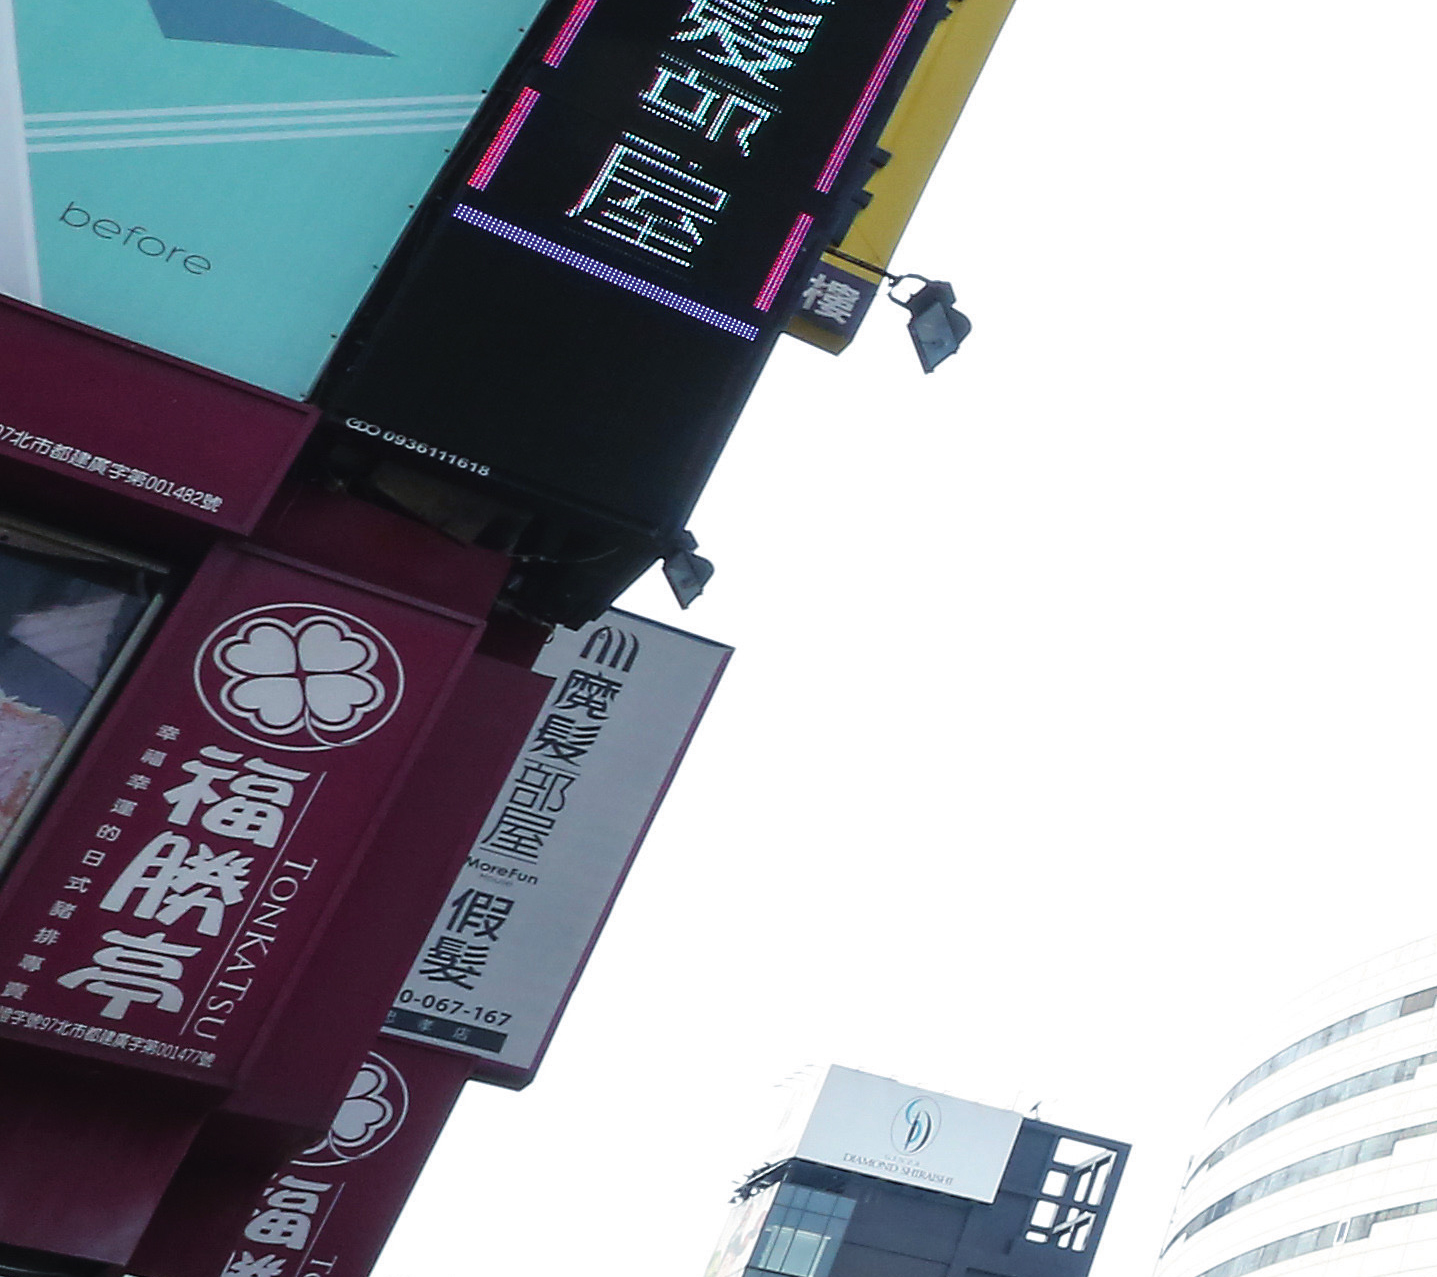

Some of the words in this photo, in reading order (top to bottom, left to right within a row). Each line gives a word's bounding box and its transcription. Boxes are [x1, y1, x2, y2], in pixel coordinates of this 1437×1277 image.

[56, 199, 215, 280] before
[383, 429, 491, 478] 0936111618
[57, 745, 311, 1021] 福勝亭
[192, 856, 319, 1042] TONKATSU
[418, 887, 515, 992] 假髮
[841, 1151, 900, 1174] DIAMOND
